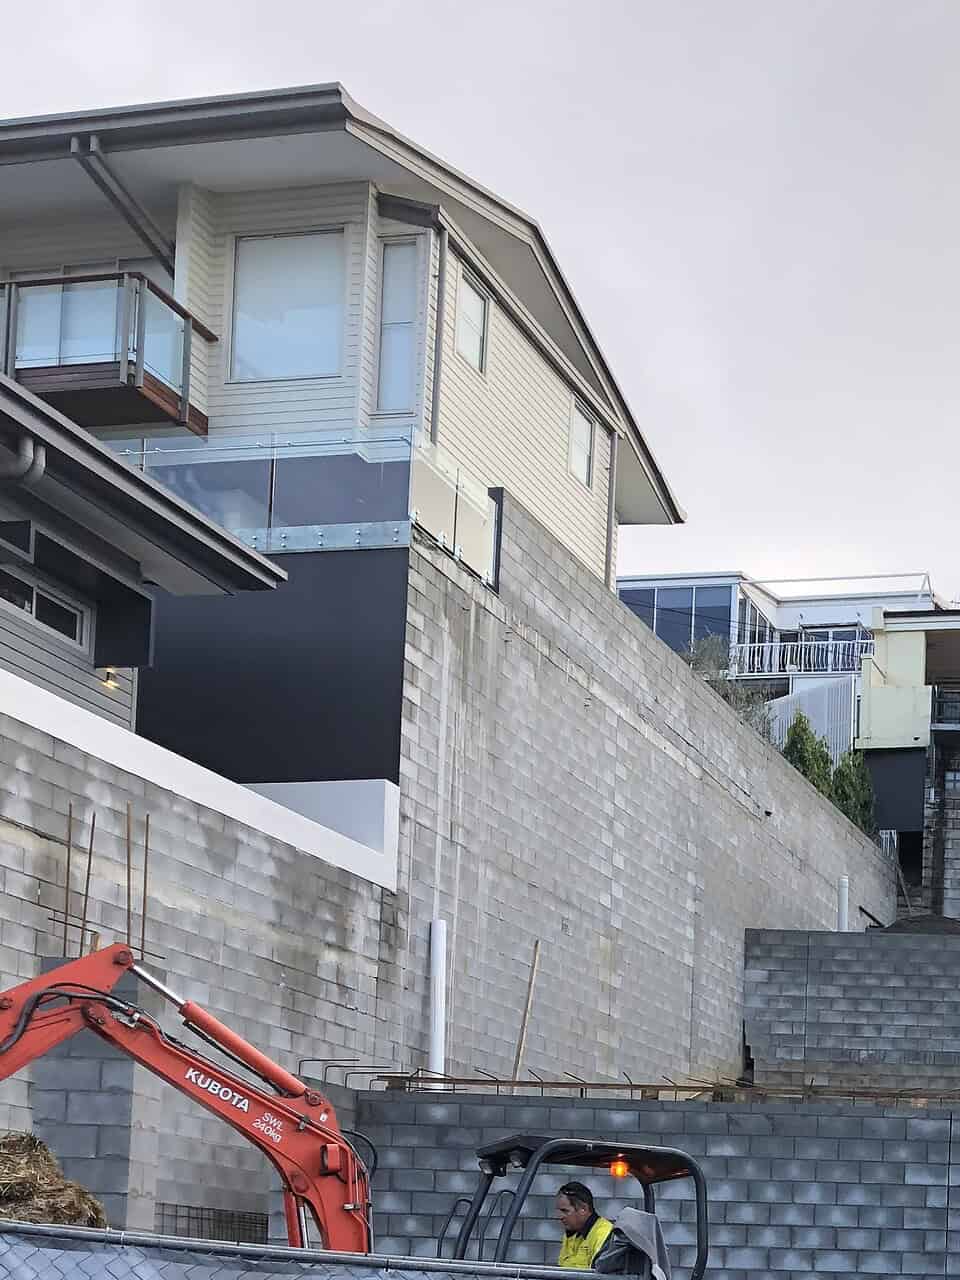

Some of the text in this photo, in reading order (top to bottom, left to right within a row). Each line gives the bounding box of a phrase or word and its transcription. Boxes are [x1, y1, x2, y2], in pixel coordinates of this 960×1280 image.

[184, 1067, 250, 1112] KUBOTA
[252, 1118, 282, 1143] 240kg
[262, 1112, 284, 1132] SWL
